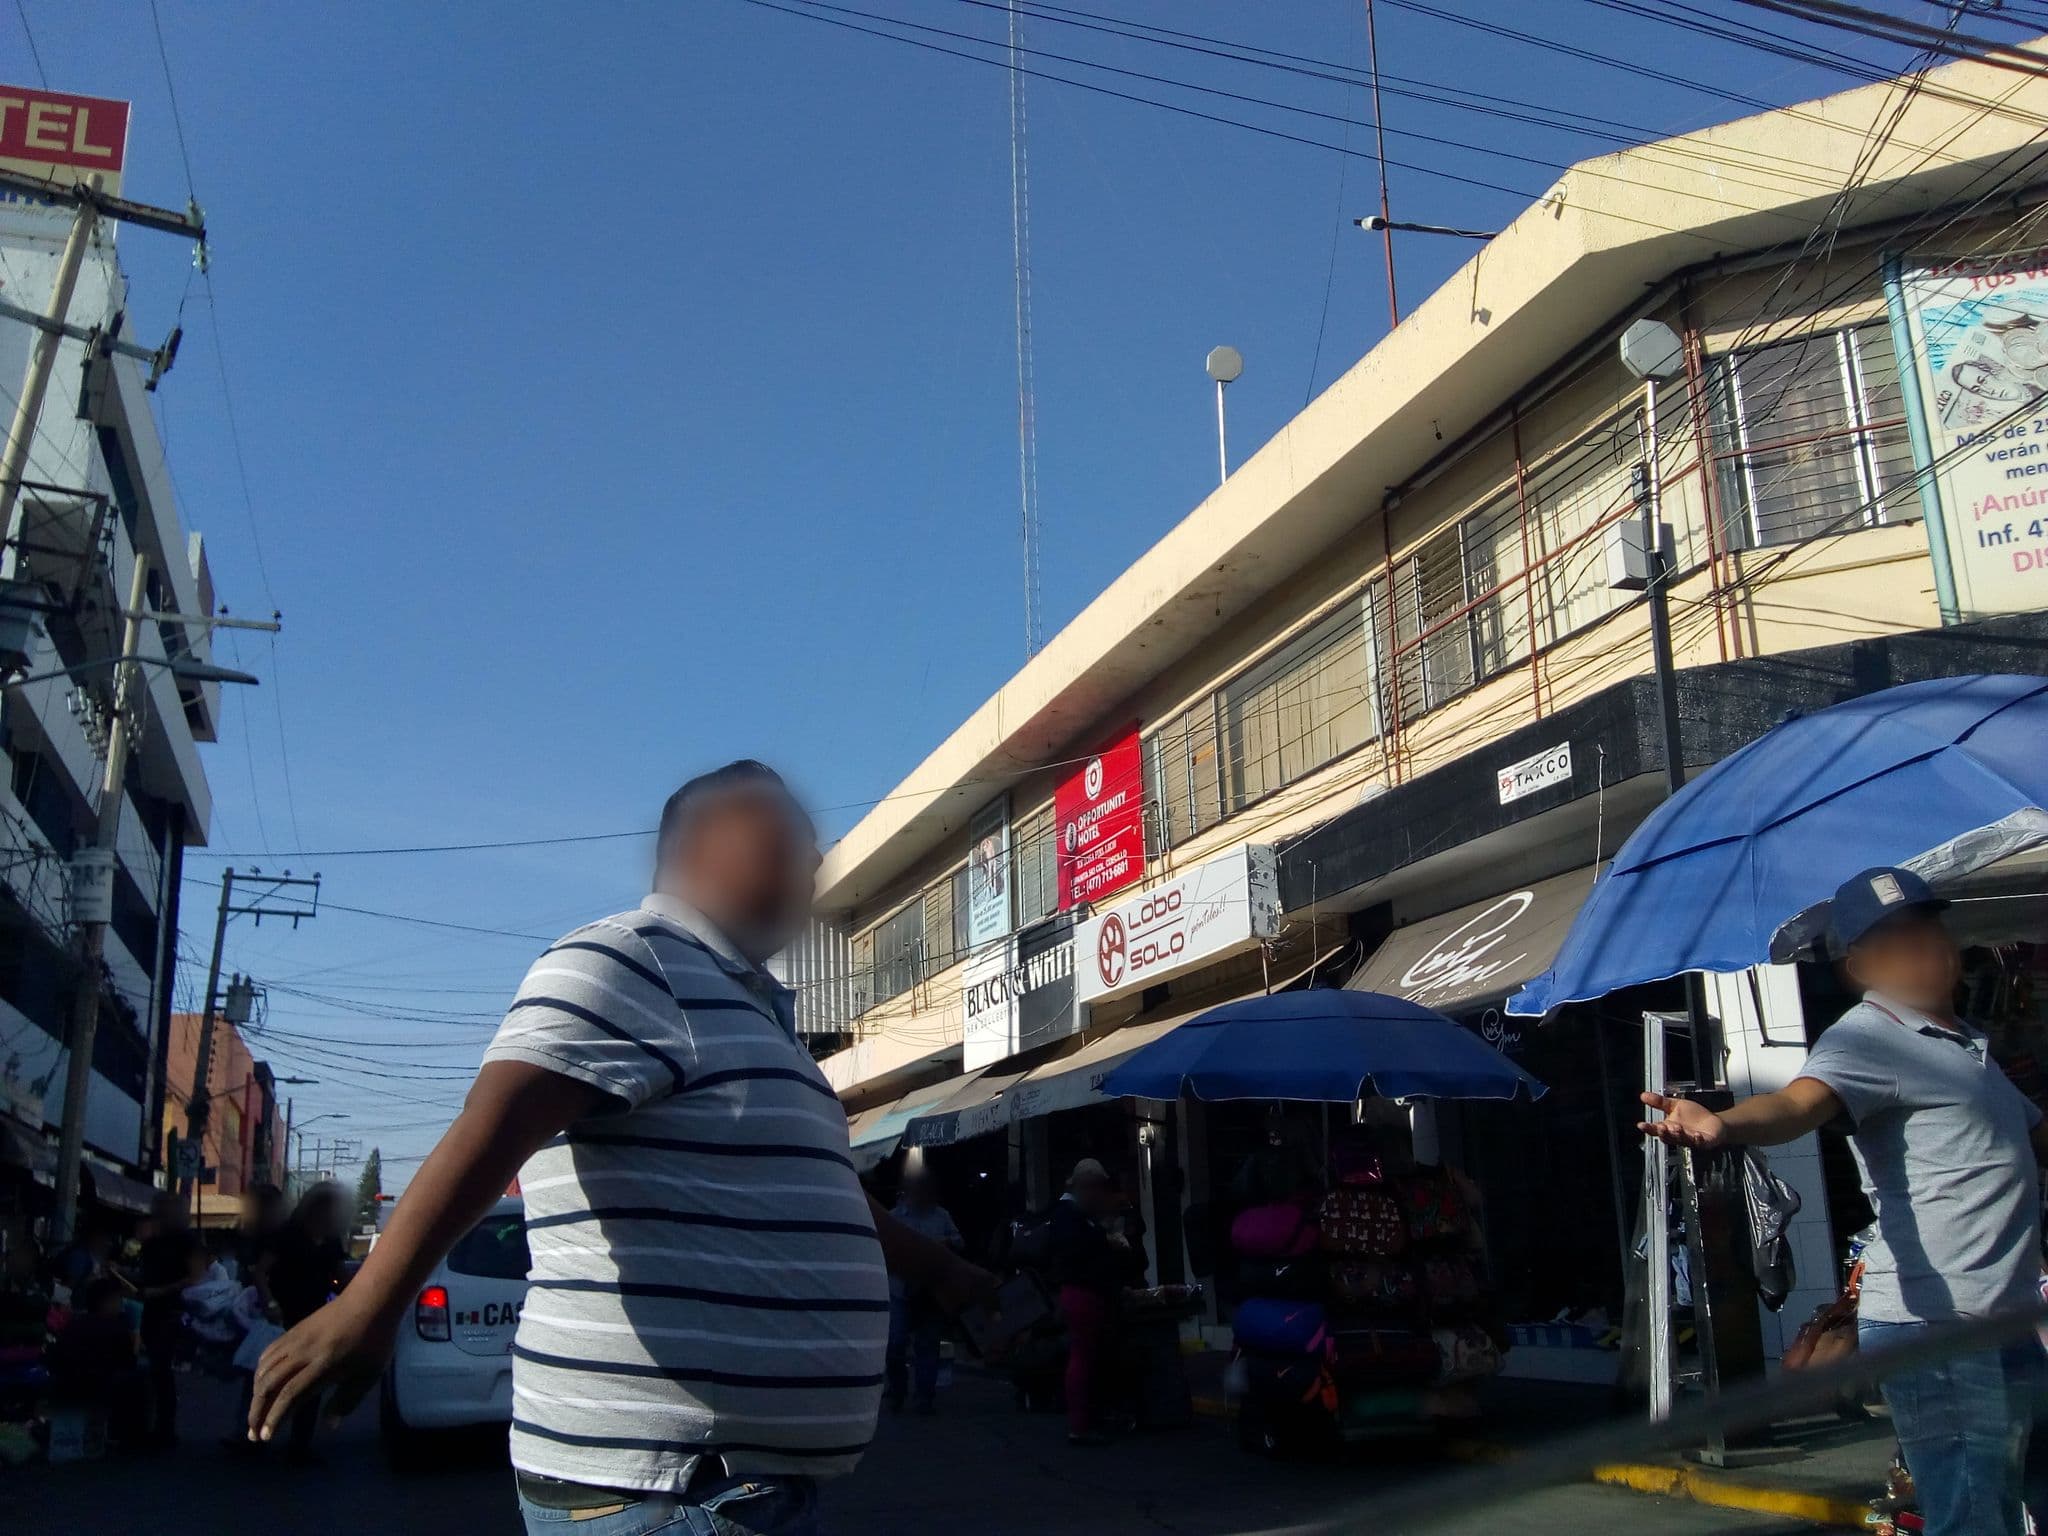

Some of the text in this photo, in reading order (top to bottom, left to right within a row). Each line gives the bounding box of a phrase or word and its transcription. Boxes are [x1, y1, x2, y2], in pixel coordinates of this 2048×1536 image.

[2003, 424, 2027, 439] de
[1986, 442, 2040, 462] verán
[1978, 522, 2020, 548] Inf.
[1515, 754, 1569, 787] TAXCO
[1077, 790, 1127, 830] OPPORTUNITY
[1077, 824, 1101, 848] HOTEL
[1131, 932, 1185, 971] SOLO
[967, 971, 1009, 1018] BLACK
[1012, 964, 1026, 997] &
